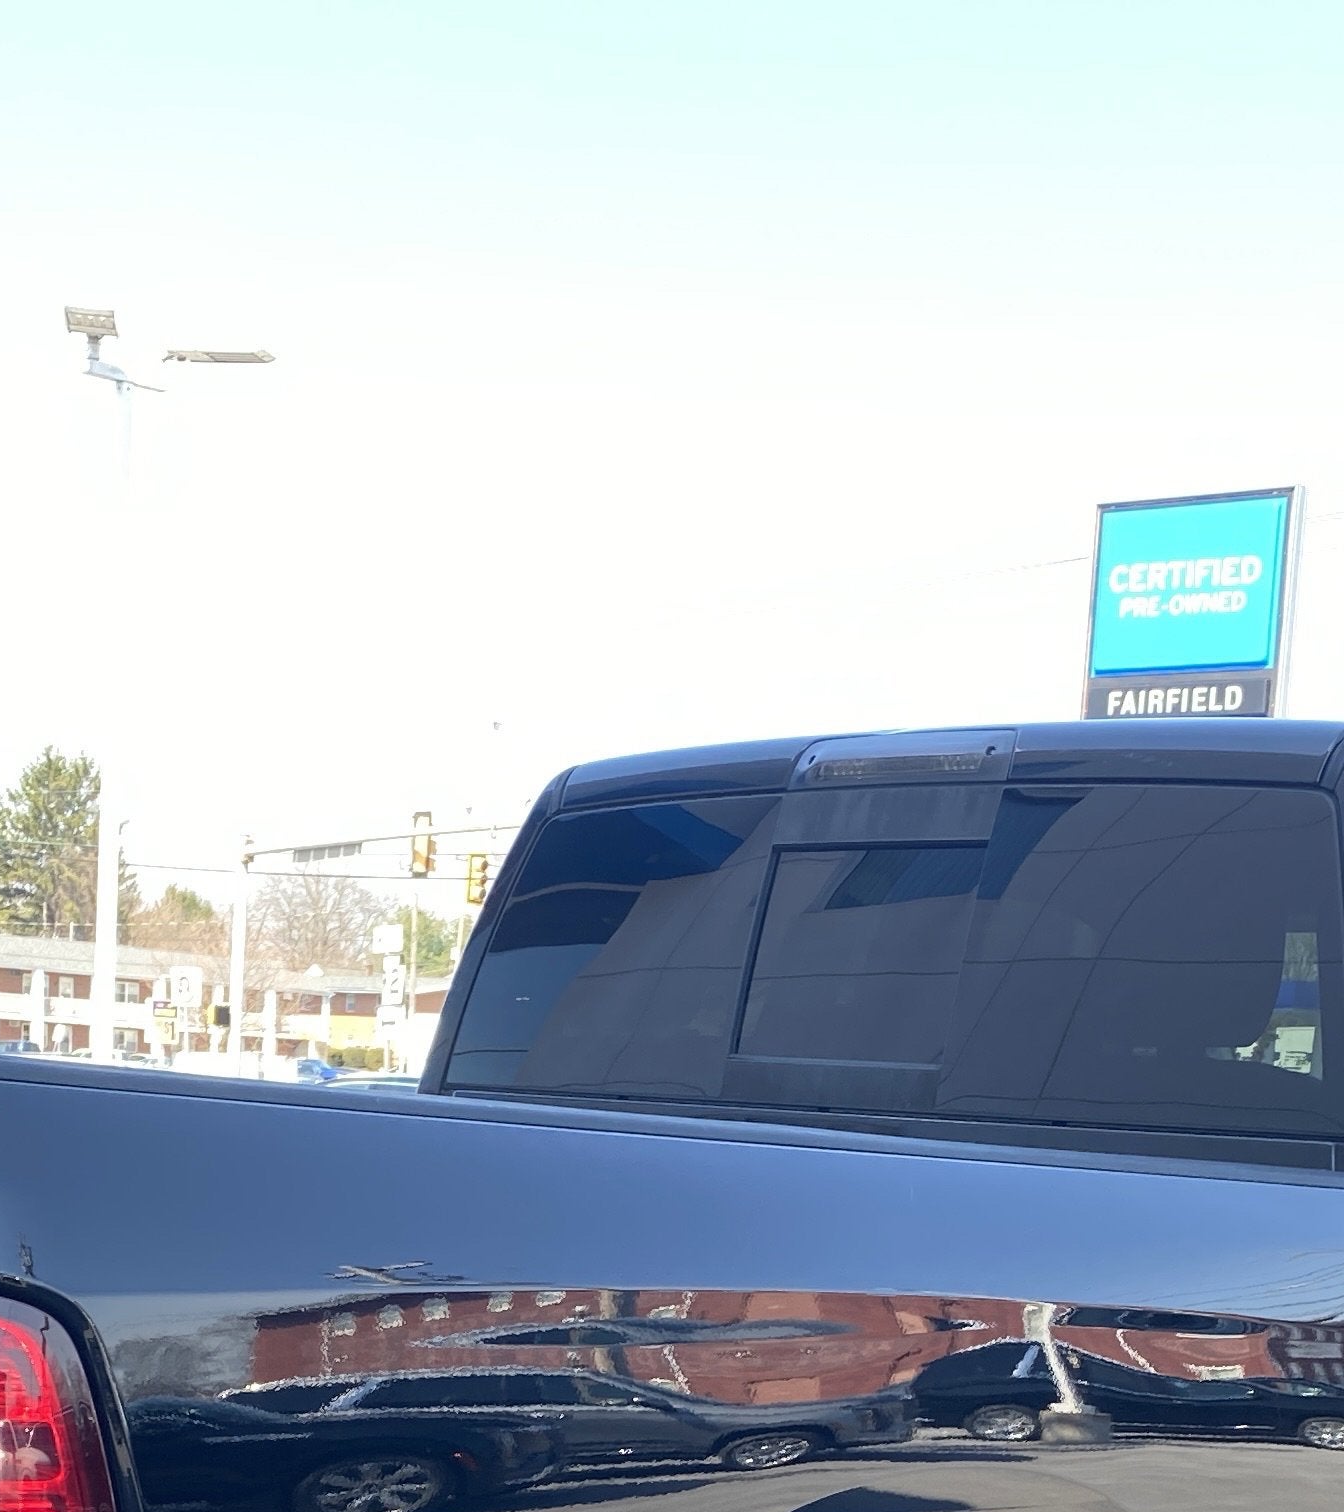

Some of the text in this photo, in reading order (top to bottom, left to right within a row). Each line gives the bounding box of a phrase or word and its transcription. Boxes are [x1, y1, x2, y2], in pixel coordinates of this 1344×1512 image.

[1109, 555, 1263, 593] CERTIFIED
[1119, 590, 1248, 618] PRE-OWNED
[1107, 685, 1243, 715] FAIRFIELD
